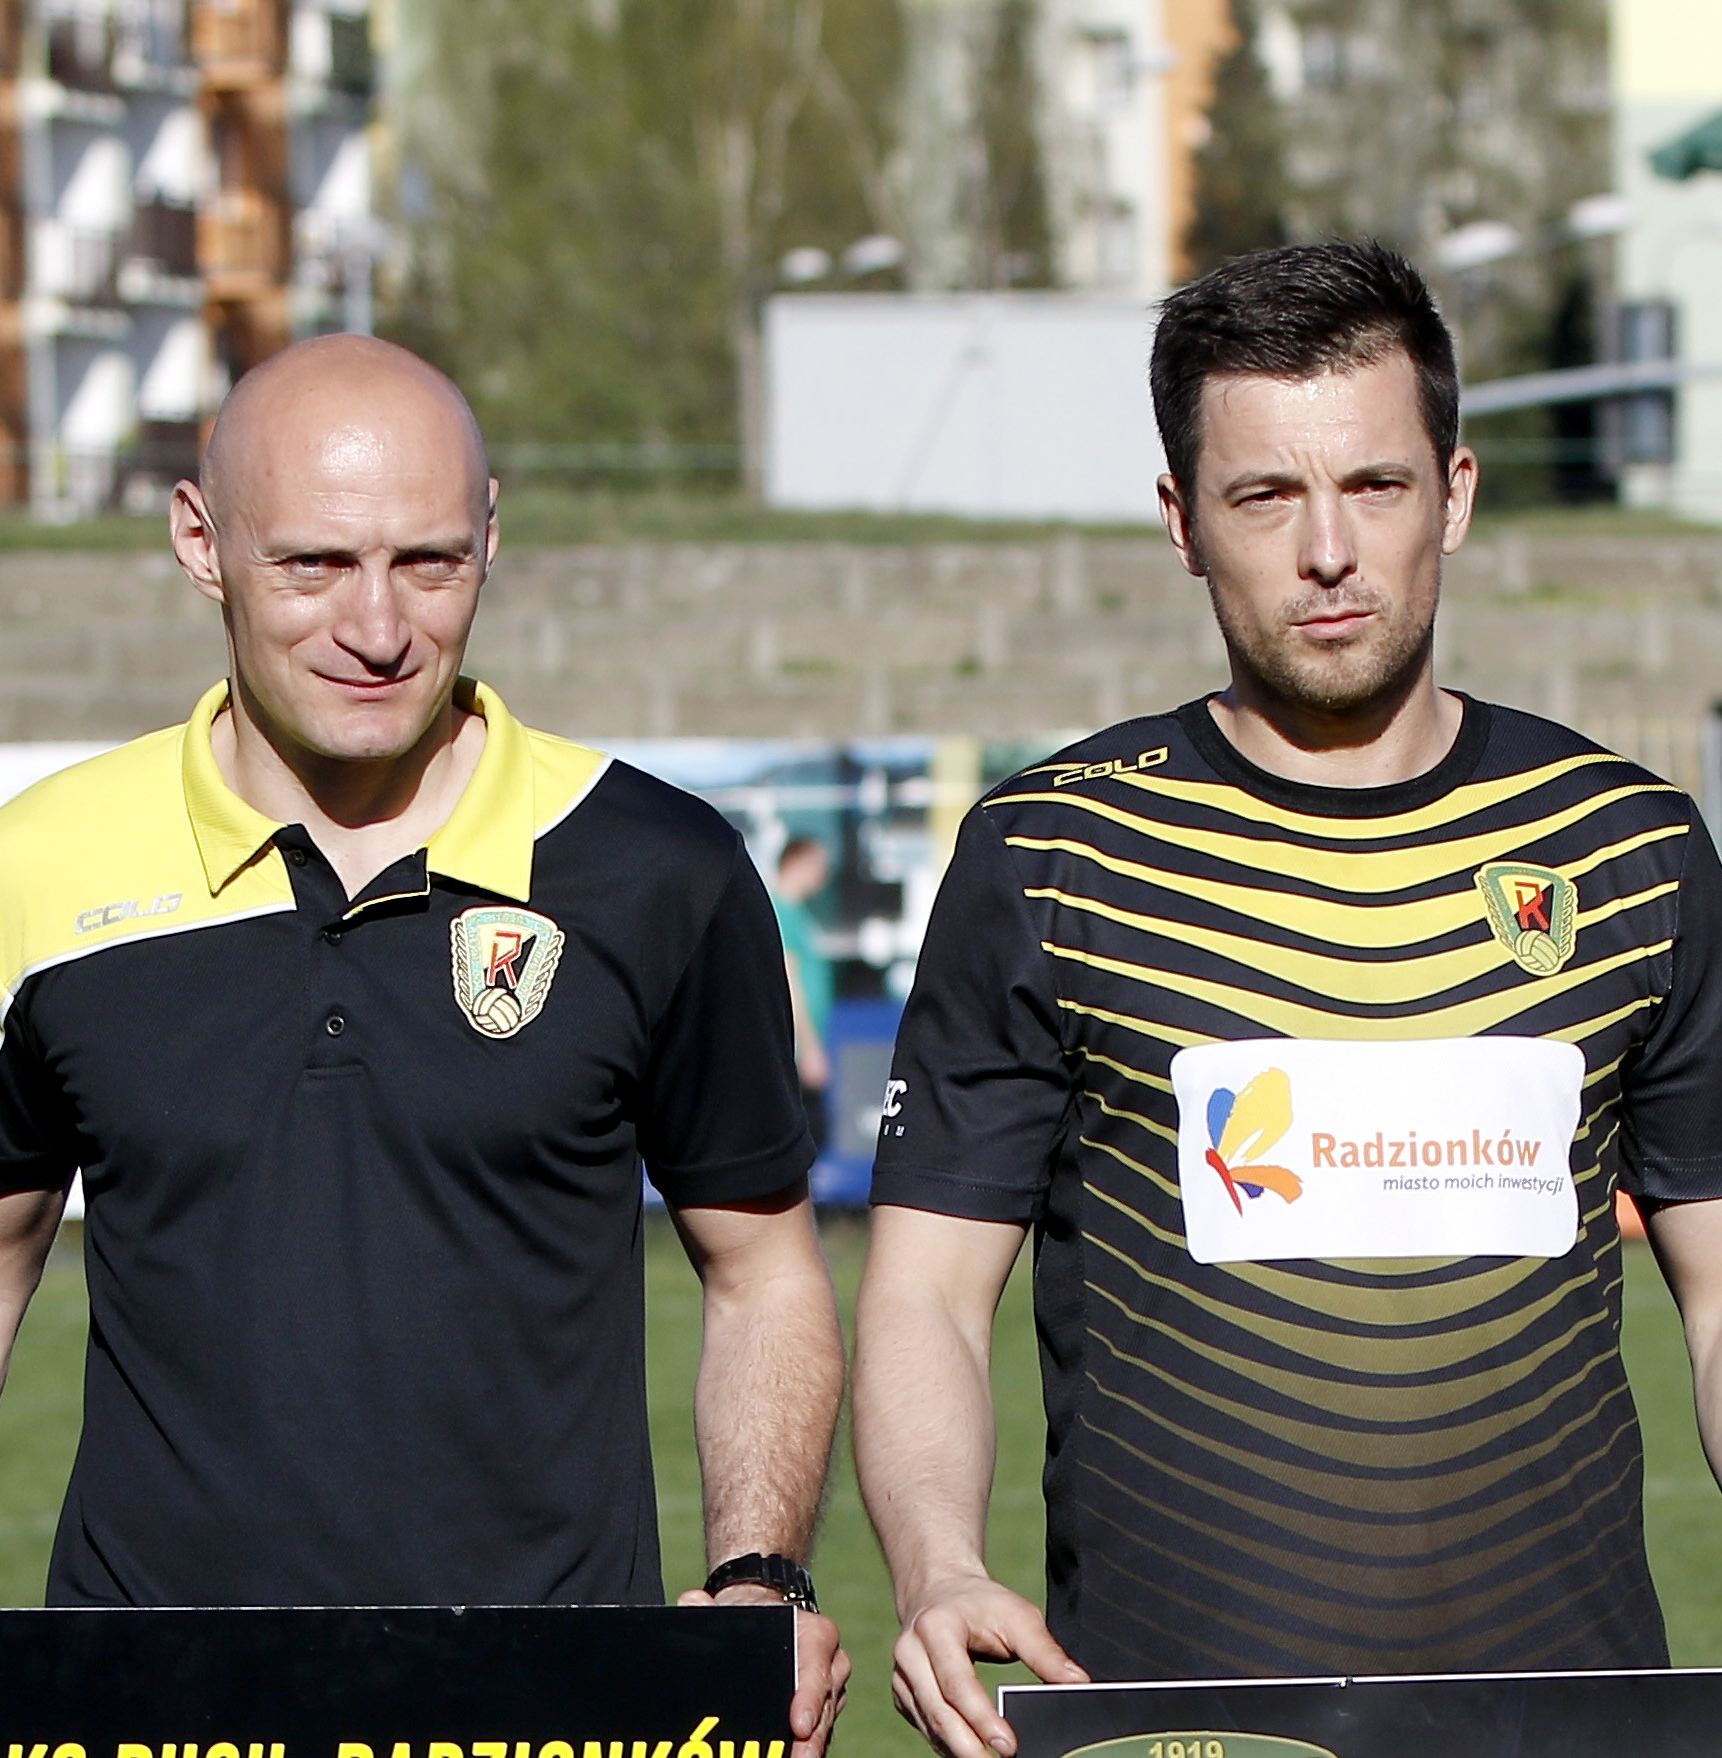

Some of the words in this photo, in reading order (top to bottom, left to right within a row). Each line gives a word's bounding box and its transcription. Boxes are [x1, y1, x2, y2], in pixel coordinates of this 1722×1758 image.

[1053, 746, 1169, 788] COLO
[75, 893, 183, 934] COLO
[1312, 1129, 1542, 1168] Radzionków
[1383, 1175, 1440, 1191] miasto
[1445, 1173, 1494, 1190] moich
[1498, 1174, 1565, 1196] inwestycji
